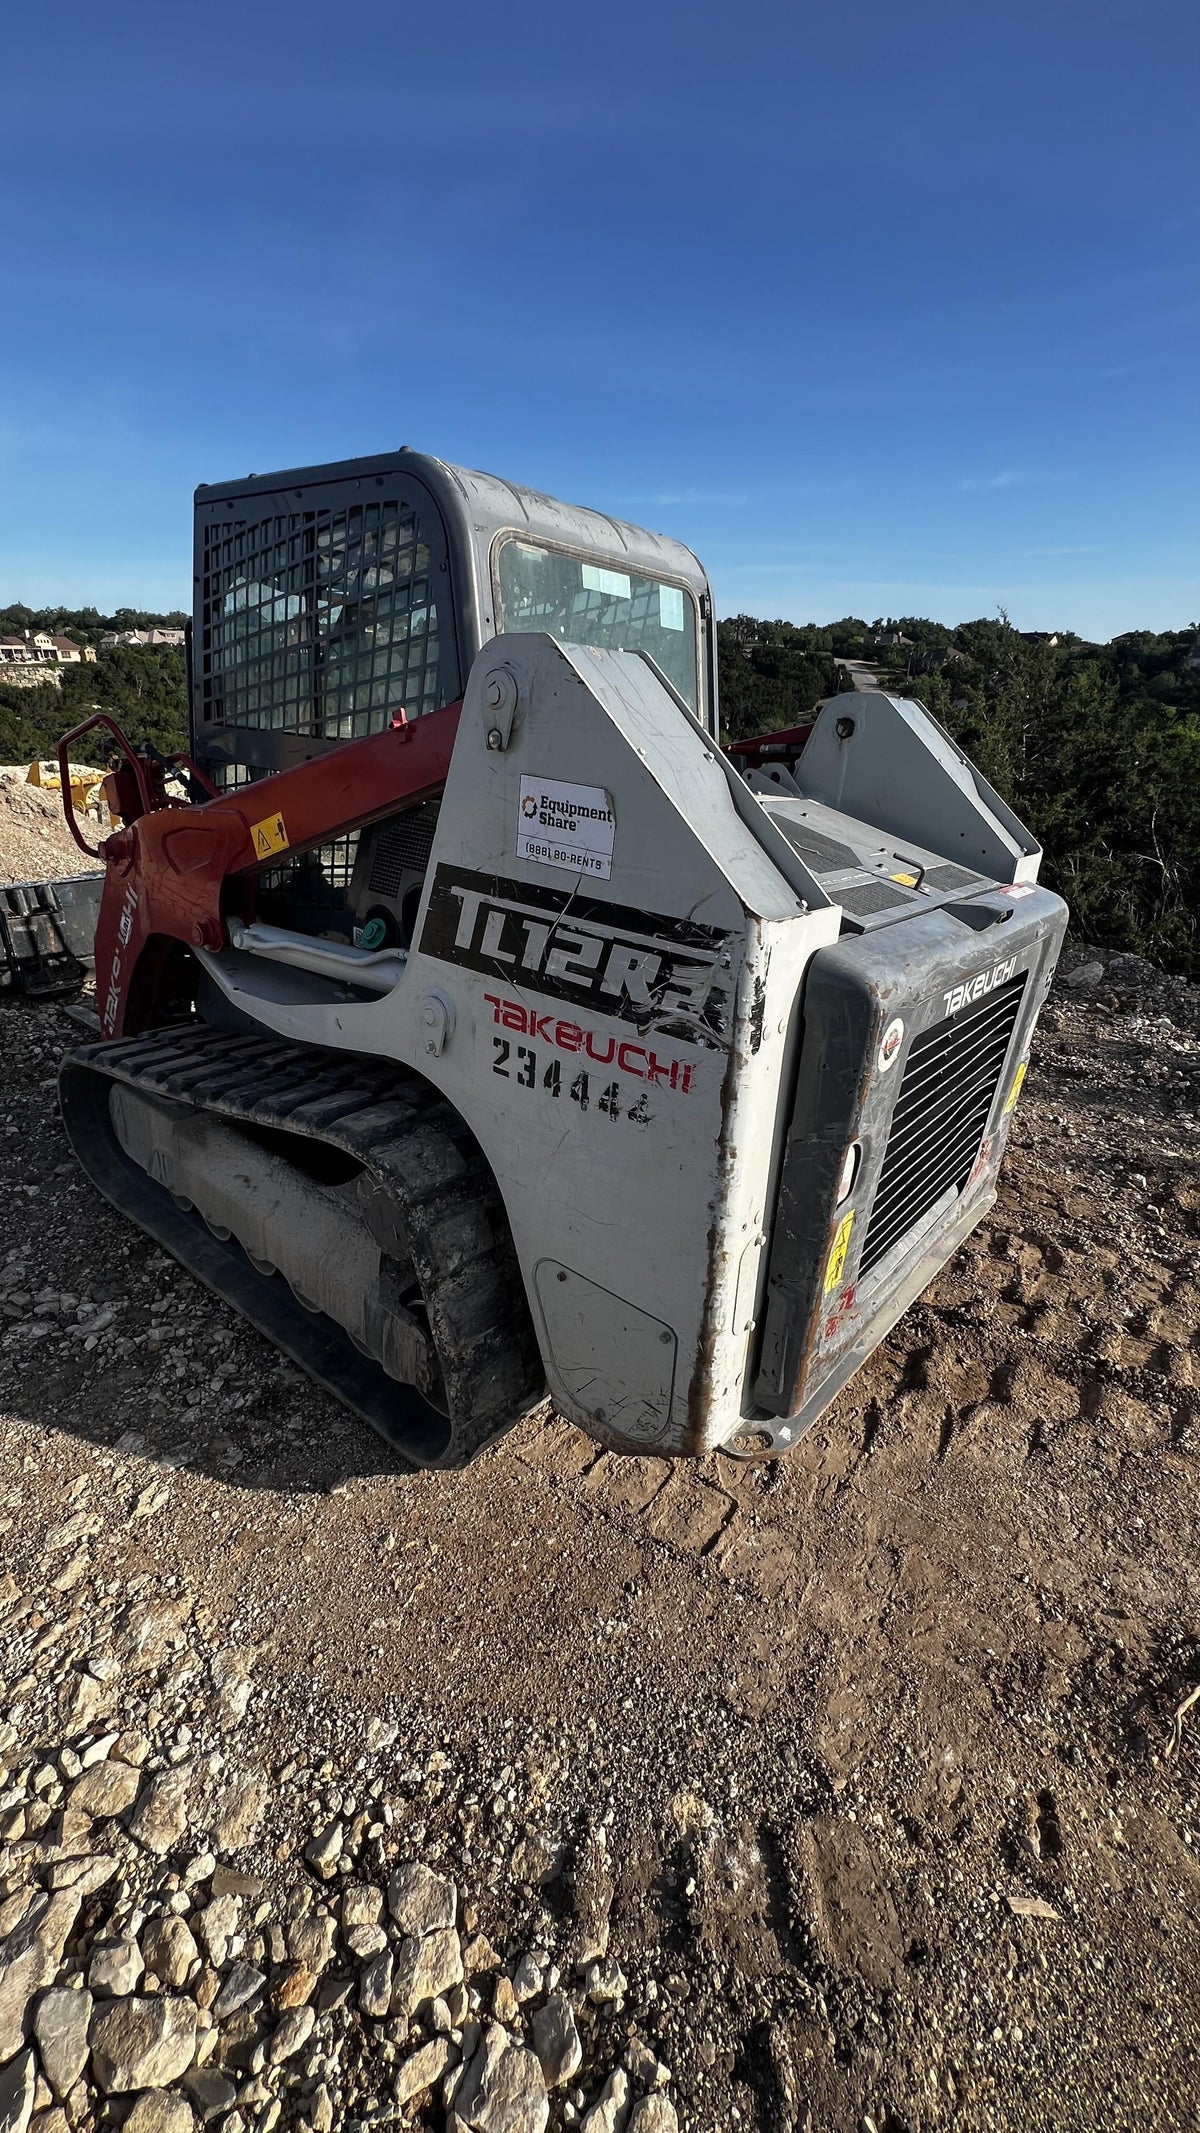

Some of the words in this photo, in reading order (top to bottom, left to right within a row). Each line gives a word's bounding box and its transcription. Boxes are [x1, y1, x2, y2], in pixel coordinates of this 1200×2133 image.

[539, 811, 577, 831] Share
[540, 795, 613, 823] Equipment
[525, 841, 551, 858] (888)
[553, 849, 602, 870] 80-RENTS
[943, 955, 1018, 1017] TAKEUCHI
[484, 993, 696, 1094] TAKEUCHI
